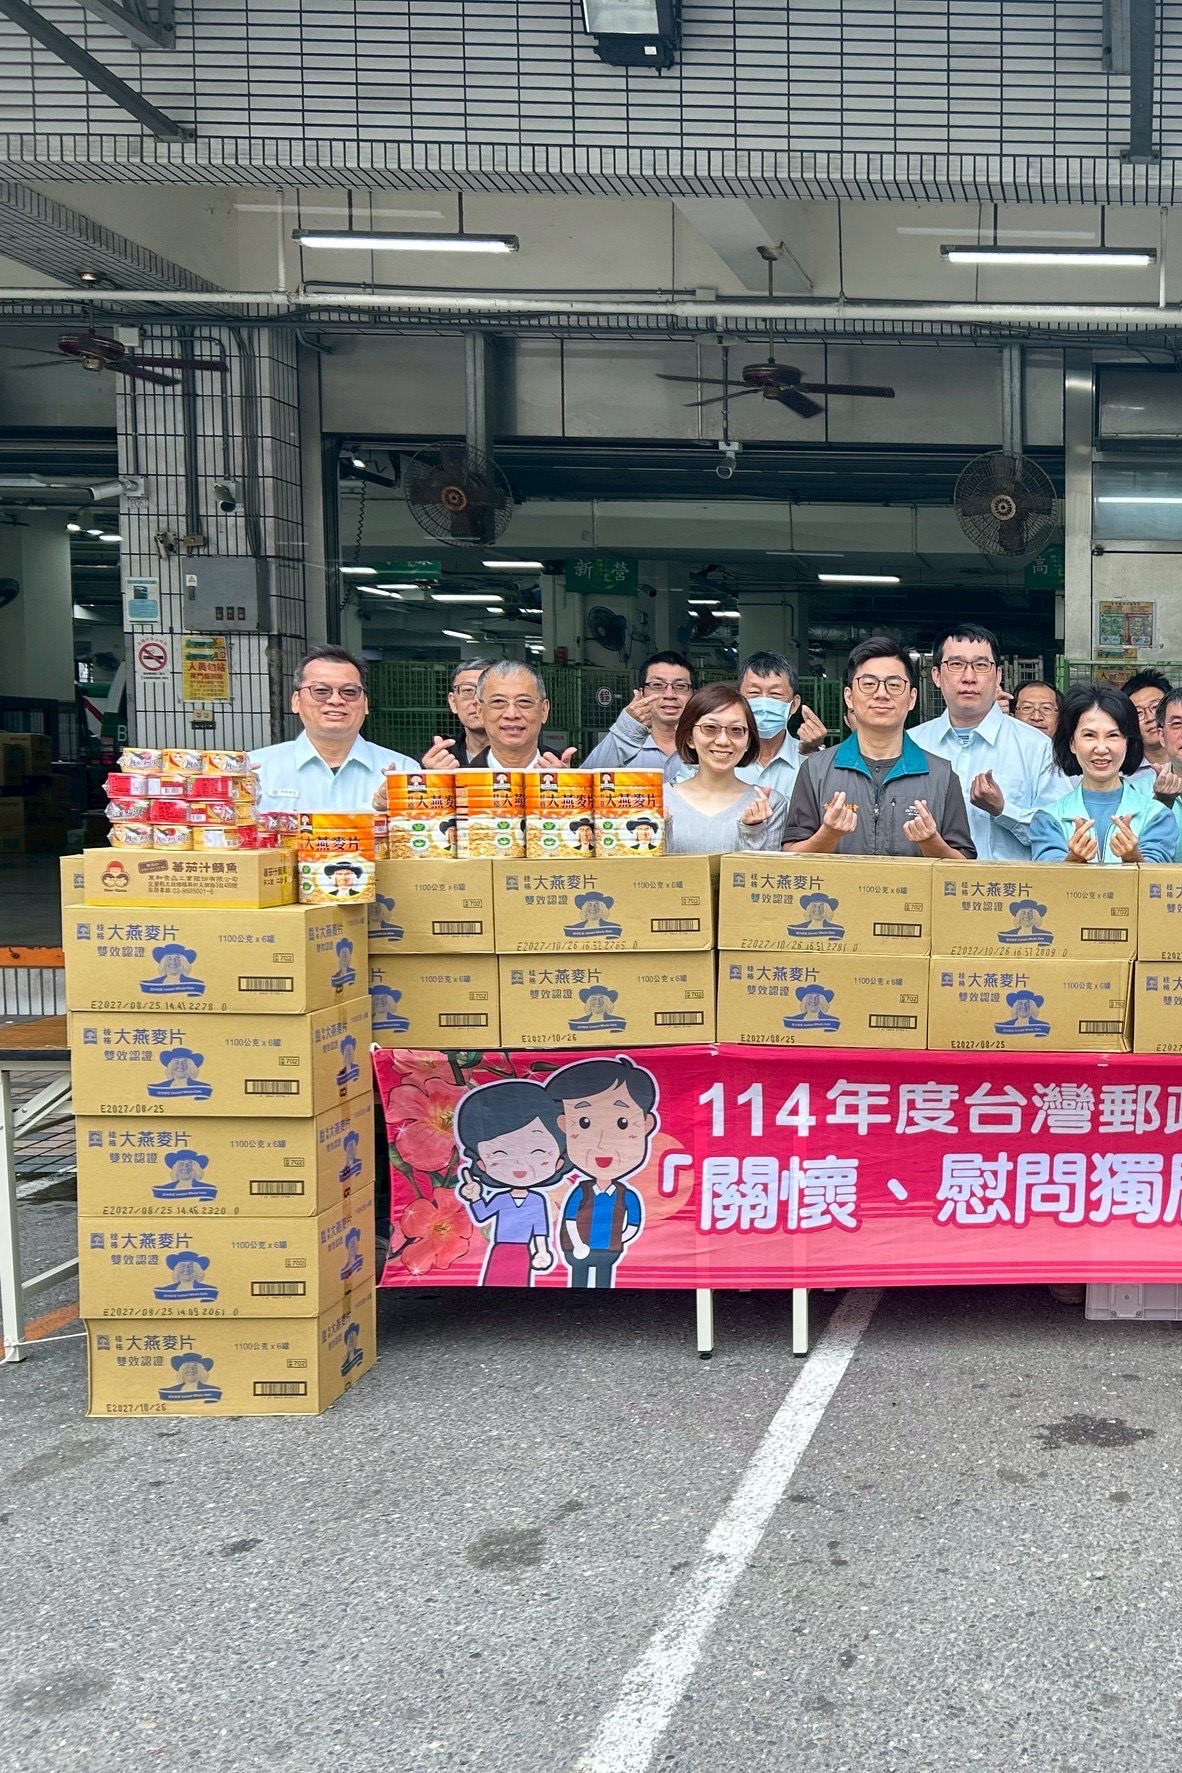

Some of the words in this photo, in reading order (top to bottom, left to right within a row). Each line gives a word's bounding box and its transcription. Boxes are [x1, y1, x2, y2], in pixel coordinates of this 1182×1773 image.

[534, 874, 598, 890] 大燕麥片
[761, 874, 824, 890] 大燕麥片
[971, 882, 1032, 897] 大燕麥片
[525, 895, 567, 905] 雙效認證
[751, 893, 793, 904] 雙效認證
[962, 901, 1003, 911] 雙效認證
[107, 924, 179, 941] 大燕麥片
[98, 946, 145, 957] 雙效認證
[539, 968, 602, 984] 大燕麥片
[757, 966, 820, 982] 大燕麥片
[968, 973, 1030, 988] 大燕麥片
[530, 989, 572, 999] 雙效認證
[747, 985, 789, 996] 雙效認證
[959, 992, 1000, 1002] 雙效認證
[114, 1028, 186, 1045] 大燕麥片
[104, 1050, 152, 1061] 雙效認證
[119, 1131, 191, 1147] 大燕麥片
[110, 1153, 158, 1163] 雙效認證
[121, 1233, 193, 1249] 大燕麥片
[111, 1255, 158, 1265] 雙效認證
[126, 1335, 196, 1350] 大燕麥片
[117, 1356, 164, 1366] 雙效認證
